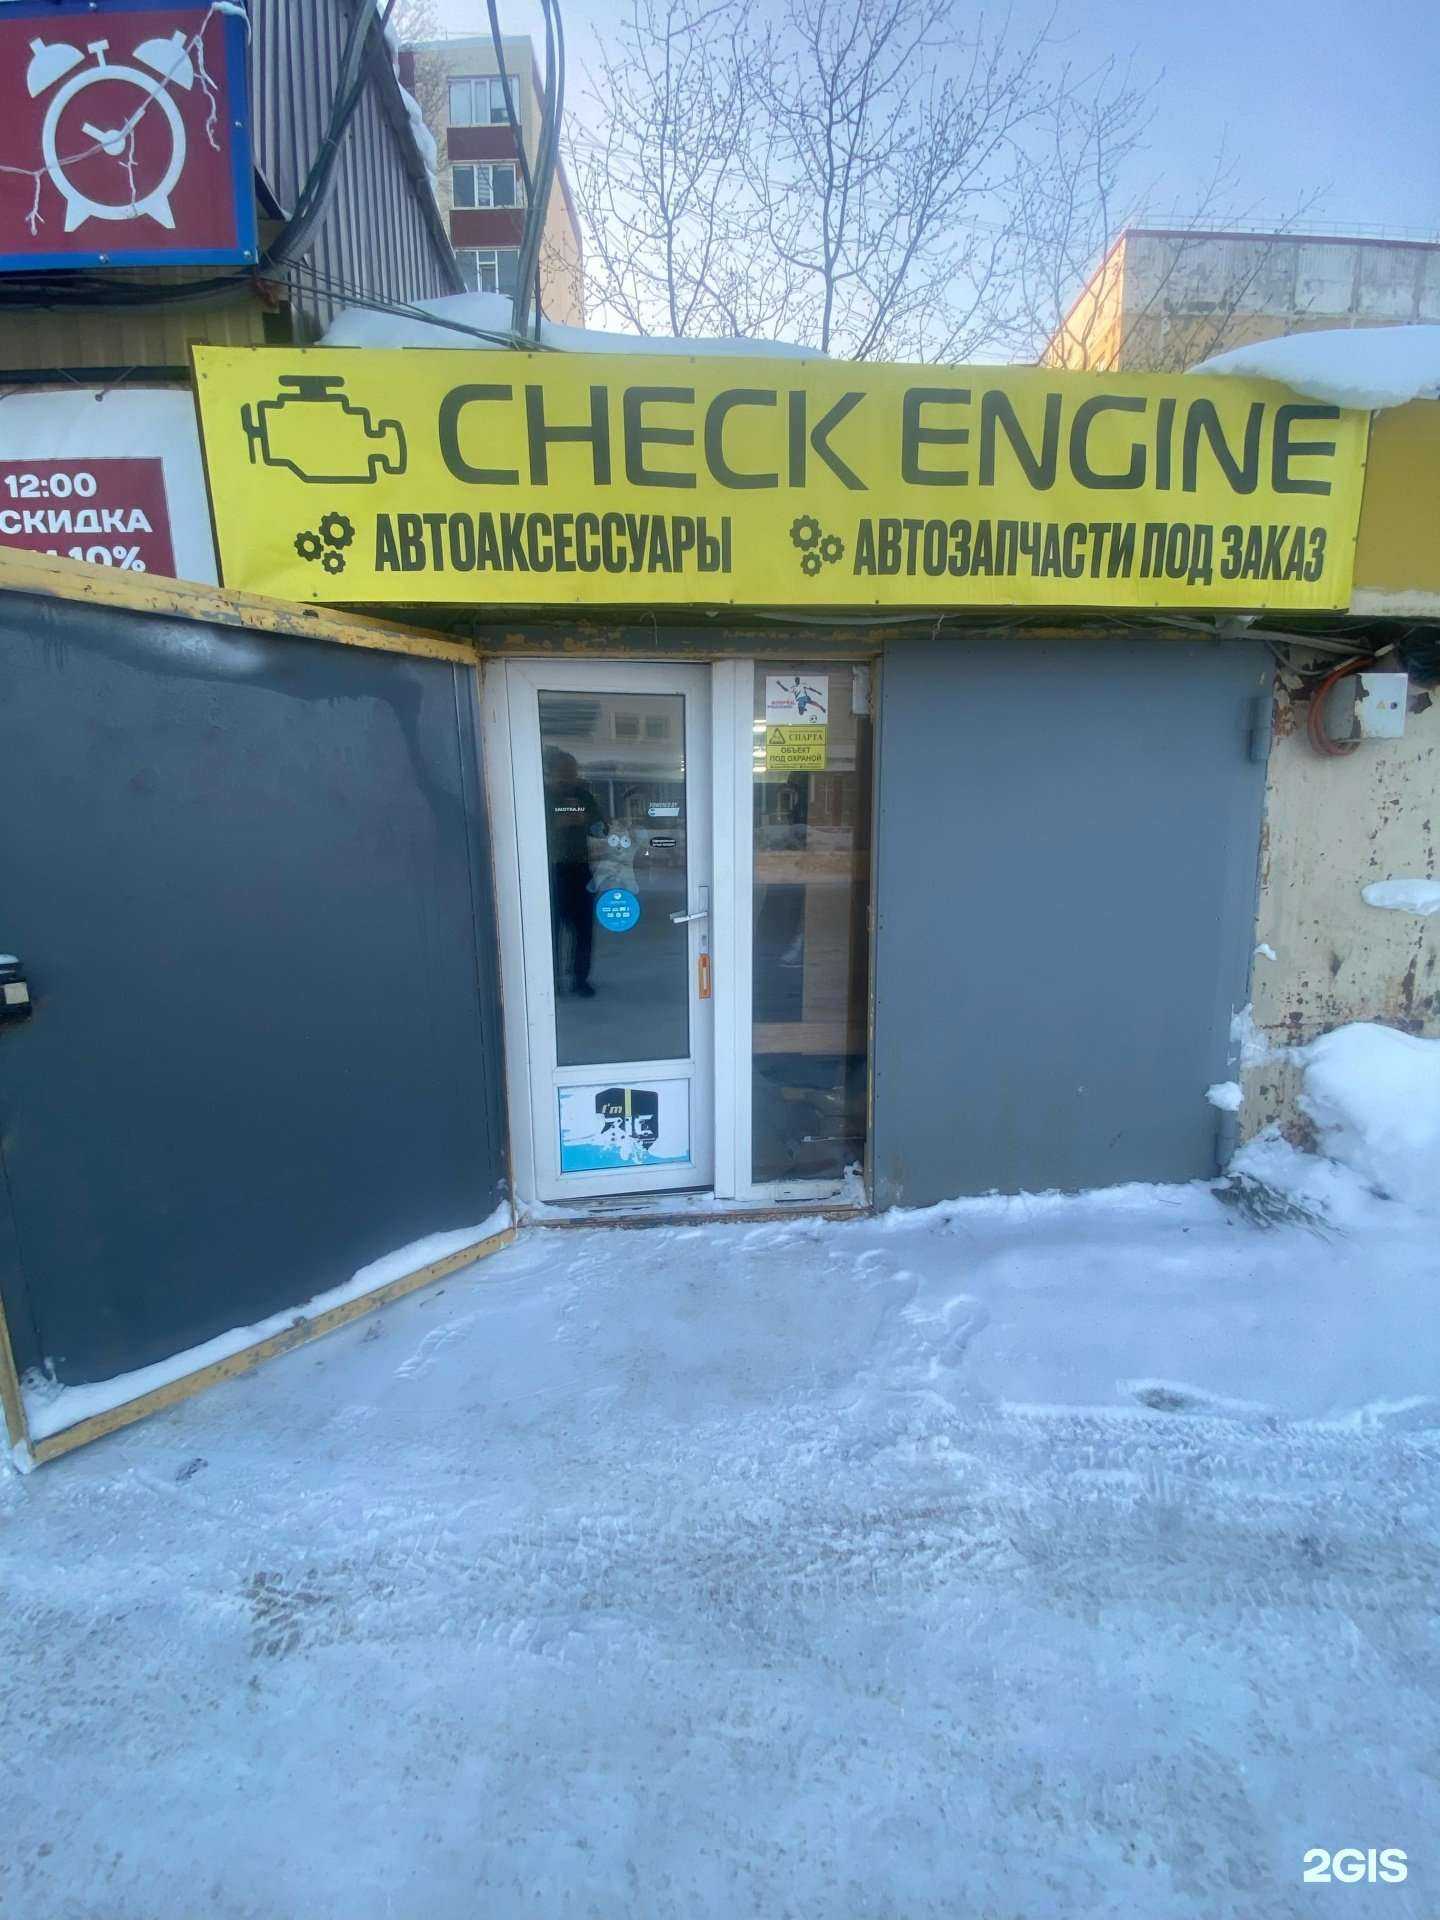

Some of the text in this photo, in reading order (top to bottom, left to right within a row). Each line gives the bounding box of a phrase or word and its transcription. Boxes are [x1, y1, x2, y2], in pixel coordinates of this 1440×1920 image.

[438, 383, 1341, 497] CHECK ENGINE
[4, 472, 97, 498] 12:00
[0, 508, 153, 534] СКИДКА
[374, 512, 732, 574] АВТОАКСЕССУАРЫ
[853, 517, 1327, 586] АВТОЗАПЧАСТИ ПОД ЗАКАЗ
[787, 754, 822, 762] ОХРАНОЙ
